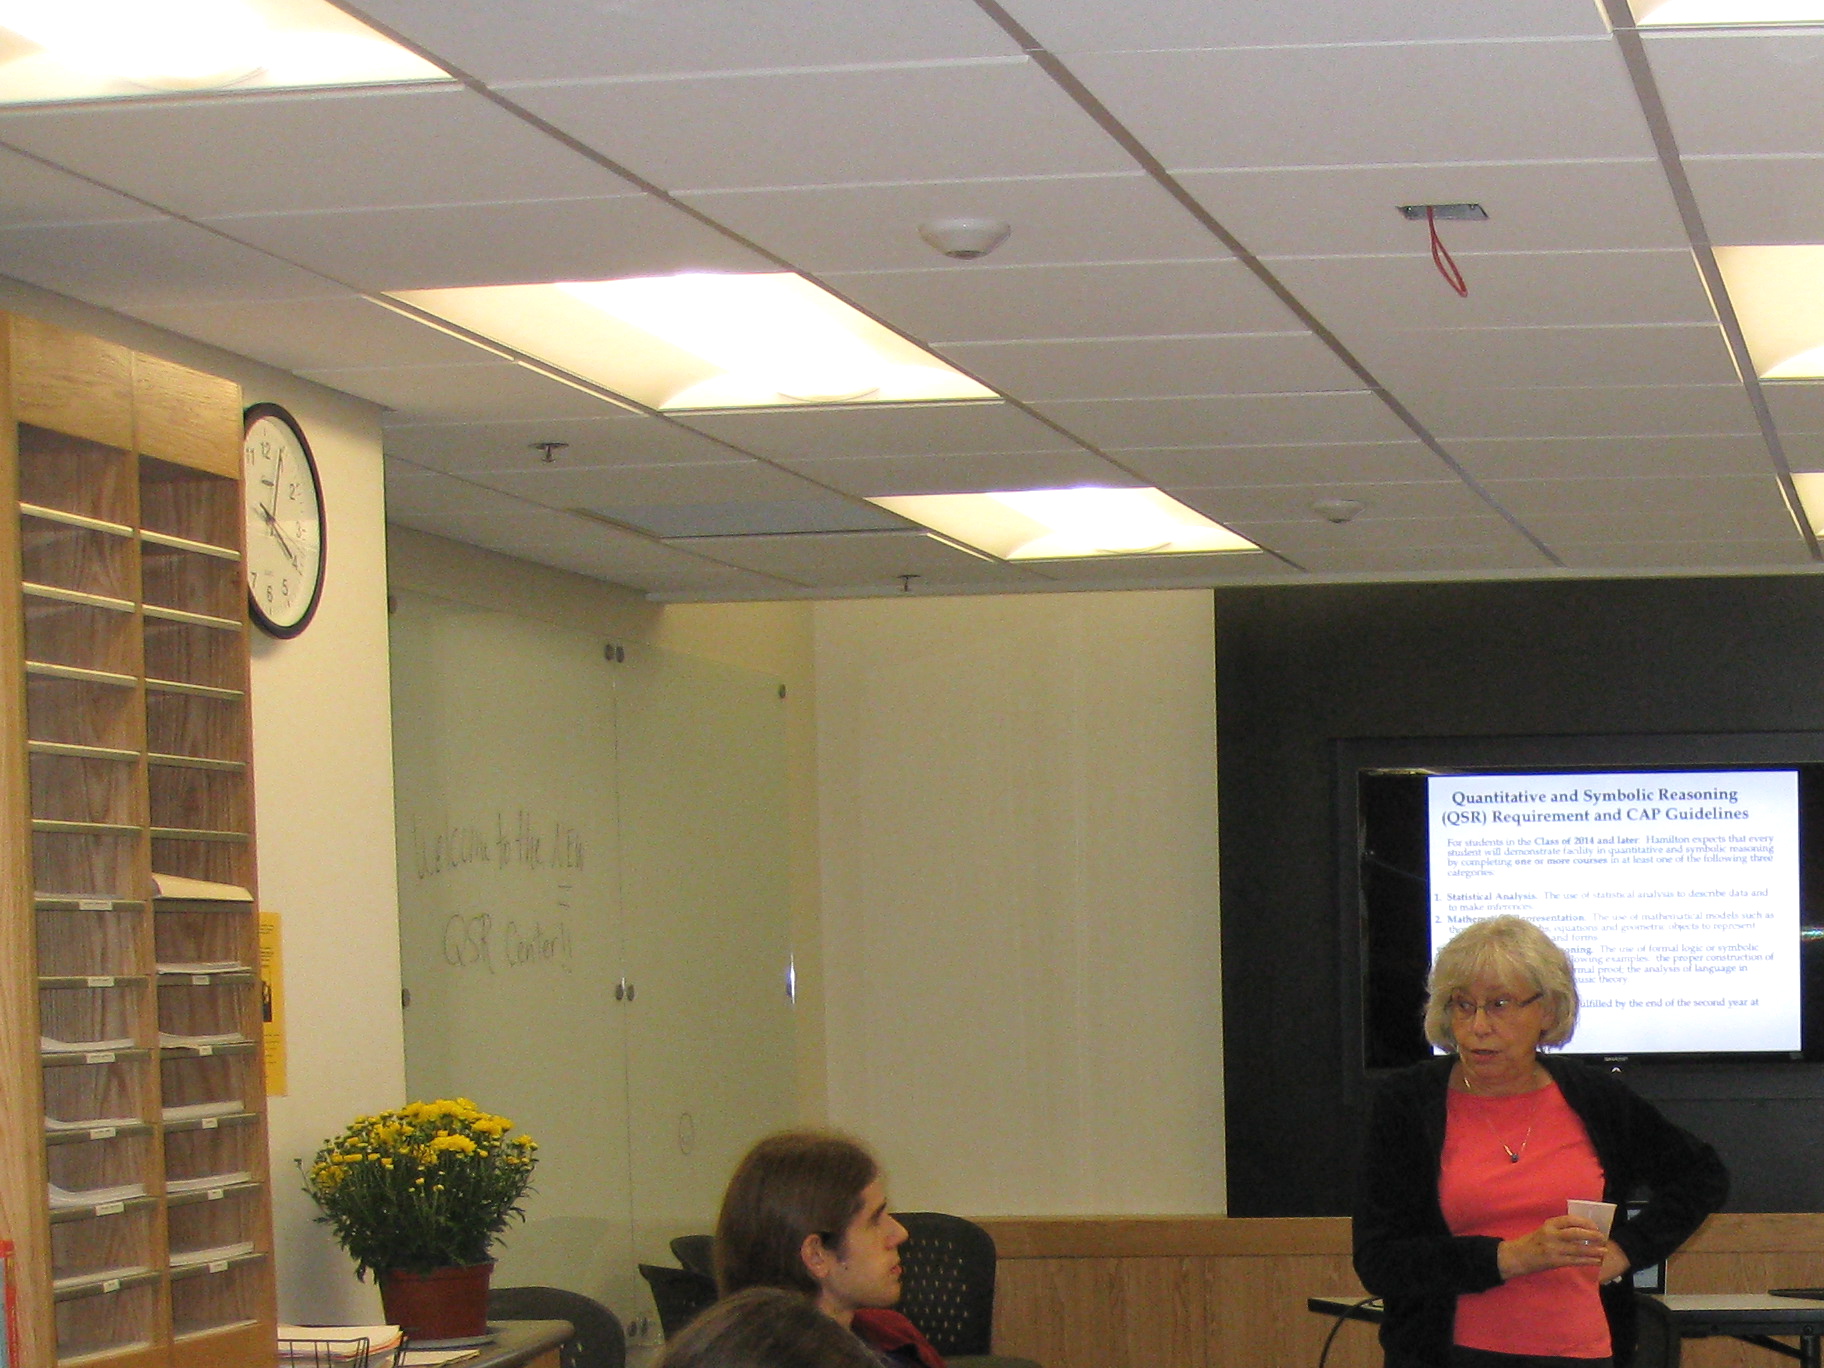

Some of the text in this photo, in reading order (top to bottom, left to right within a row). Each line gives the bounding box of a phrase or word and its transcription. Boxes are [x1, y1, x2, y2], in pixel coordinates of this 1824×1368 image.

[1452, 788, 1738, 807] Quantitative and Symbolic Reasoning
[1441, 807, 1749, 826] (QSR) Requirement and CAP Guidelines
[1447, 838, 1462, 847] For
[1465, 837, 1503, 846] students
[1506, 837, 1514, 846] in
[1518, 837, 1531, 845] the
[1534, 837, 1559, 845] Class
[1562, 836, 1571, 845] of
[1574, 836, 1594, 845] 2014
[1597, 836, 1614, 845] and
[1646, 835, 1689, 843] Hamilton
[1692, 835, 1725, 845] expects
[1749, 835, 1773, 845] every
[1448, 848, 1481, 856] student
[1504, 847, 1560, 856] demonstrate
[1563, 846, 1593, 857] facility
[1597, 846, 1606, 854] in
[1608, 845, 1663, 857] quantitative
[1666, 845, 1683, 853] and
[1686, 845, 1725, 854] symbolic
[1730, 844, 1774, 854] reasoning
[1448, 857, 1458, 868] by
[1461, 858, 1512, 868] completing
[1633, 855, 1653, 863] least
[1687, 854, 1701, 862] the
[1704, 854, 1747, 864] following
[1750, 854, 1772, 862] three
[1447, 893, 1492, 901] Statistical
[1496, 892, 1537, 902] Analysis.
[1638, 890, 1674, 898] analysis
[1688, 889, 1725, 897] describe
[1729, 889, 1748, 897] data
[1751, 888, 1768, 896] and
[1460, 903, 1484, 911] make
[1742, 911, 1762, 919] such
[1714, 922, 1755, 931] represent
[441, 912, 494, 975] QSR
[1649, 944, 1678, 952] formal
[1682, 944, 1702, 954] logic
[1718, 943, 1758, 952] symbolic
[1673, 954, 1703, 965] proper
[1706, 953, 1763, 961] construction
[1765, 952, 1774, 960] of
[1628, 965, 1641, 973] the
[1644, 965, 1680, 975] analysis
[1683, 964, 1692, 972] of
[1695, 964, 1736, 974] language
[1580, 998, 1759, 1010] ulfilled by the end of the second year at
